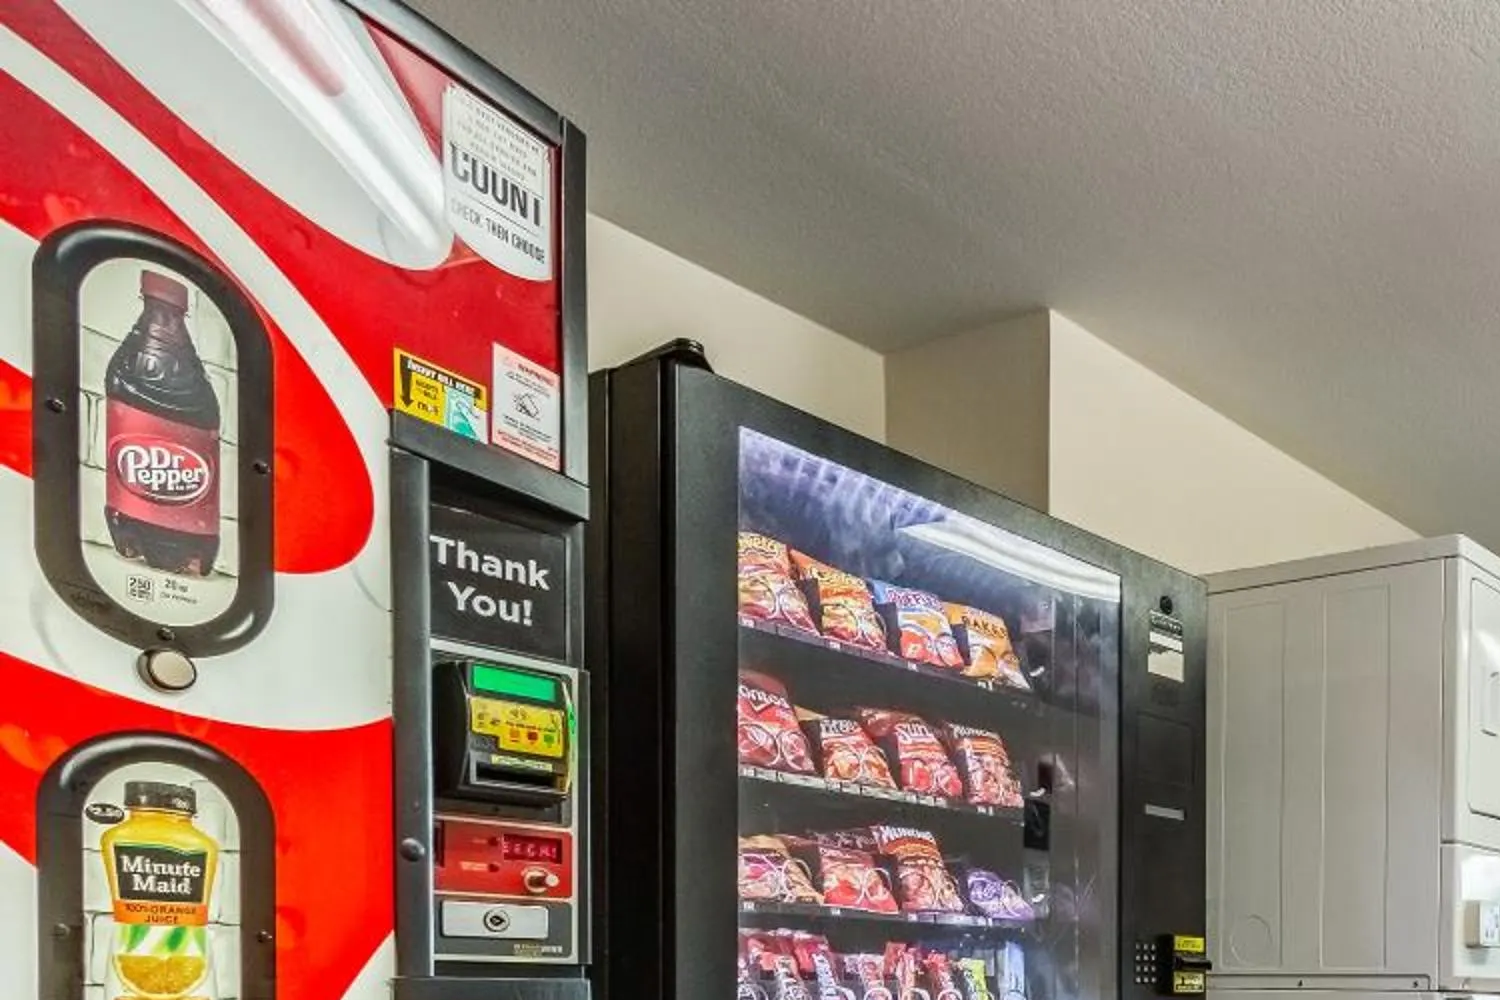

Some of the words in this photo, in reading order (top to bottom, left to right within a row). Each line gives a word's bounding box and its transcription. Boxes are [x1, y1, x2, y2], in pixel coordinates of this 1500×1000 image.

[117, 445, 203, 491] Pepper
[150, 446, 185, 469] Dr
[429, 535, 550, 591] Thank
[447, 581, 533, 627] You!
[120, 854, 201, 877] Minute
[132, 874, 192, 894] Maid
